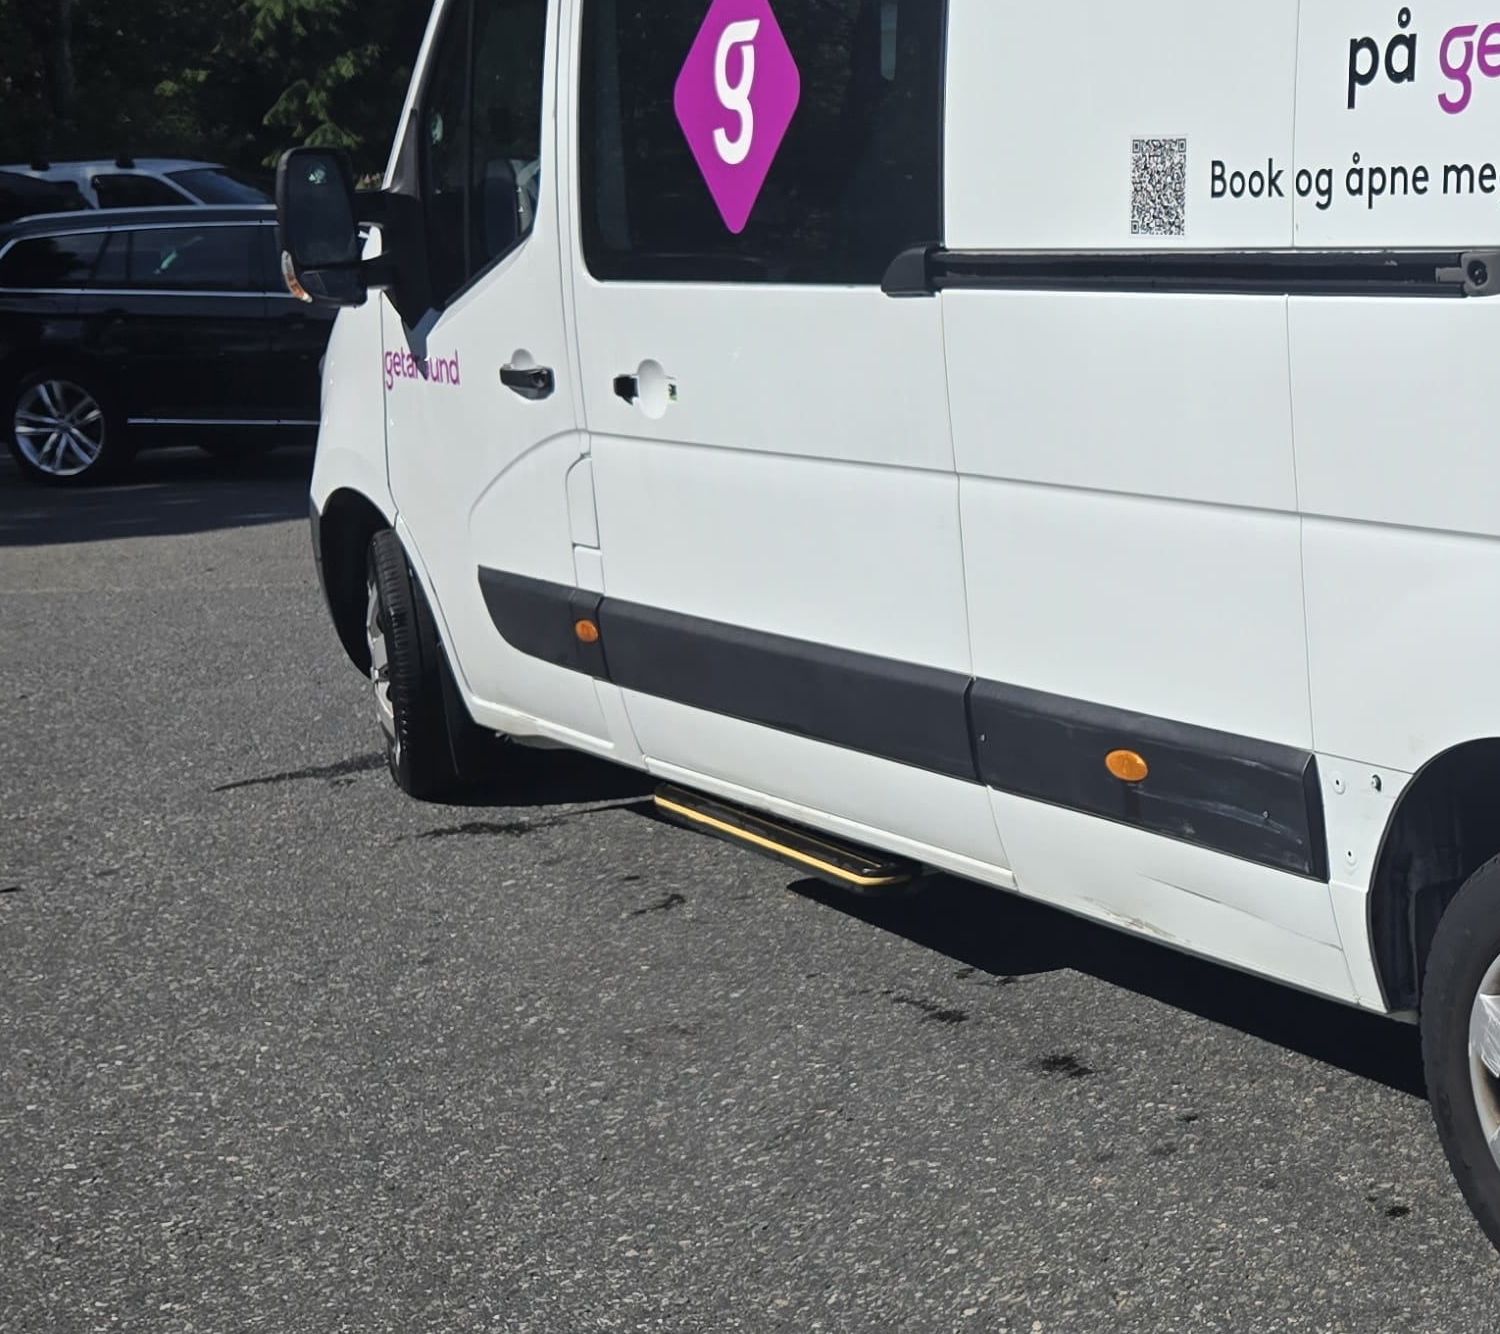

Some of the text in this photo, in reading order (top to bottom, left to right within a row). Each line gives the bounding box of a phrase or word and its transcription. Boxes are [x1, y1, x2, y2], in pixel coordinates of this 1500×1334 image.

[712, 18, 761, 165] g
[1347, 6, 1418, 110] på
[1210, 157, 1285, 199] Book
[1295, 168, 1333, 211] og
[1345, 151, 1430, 210] åpne
